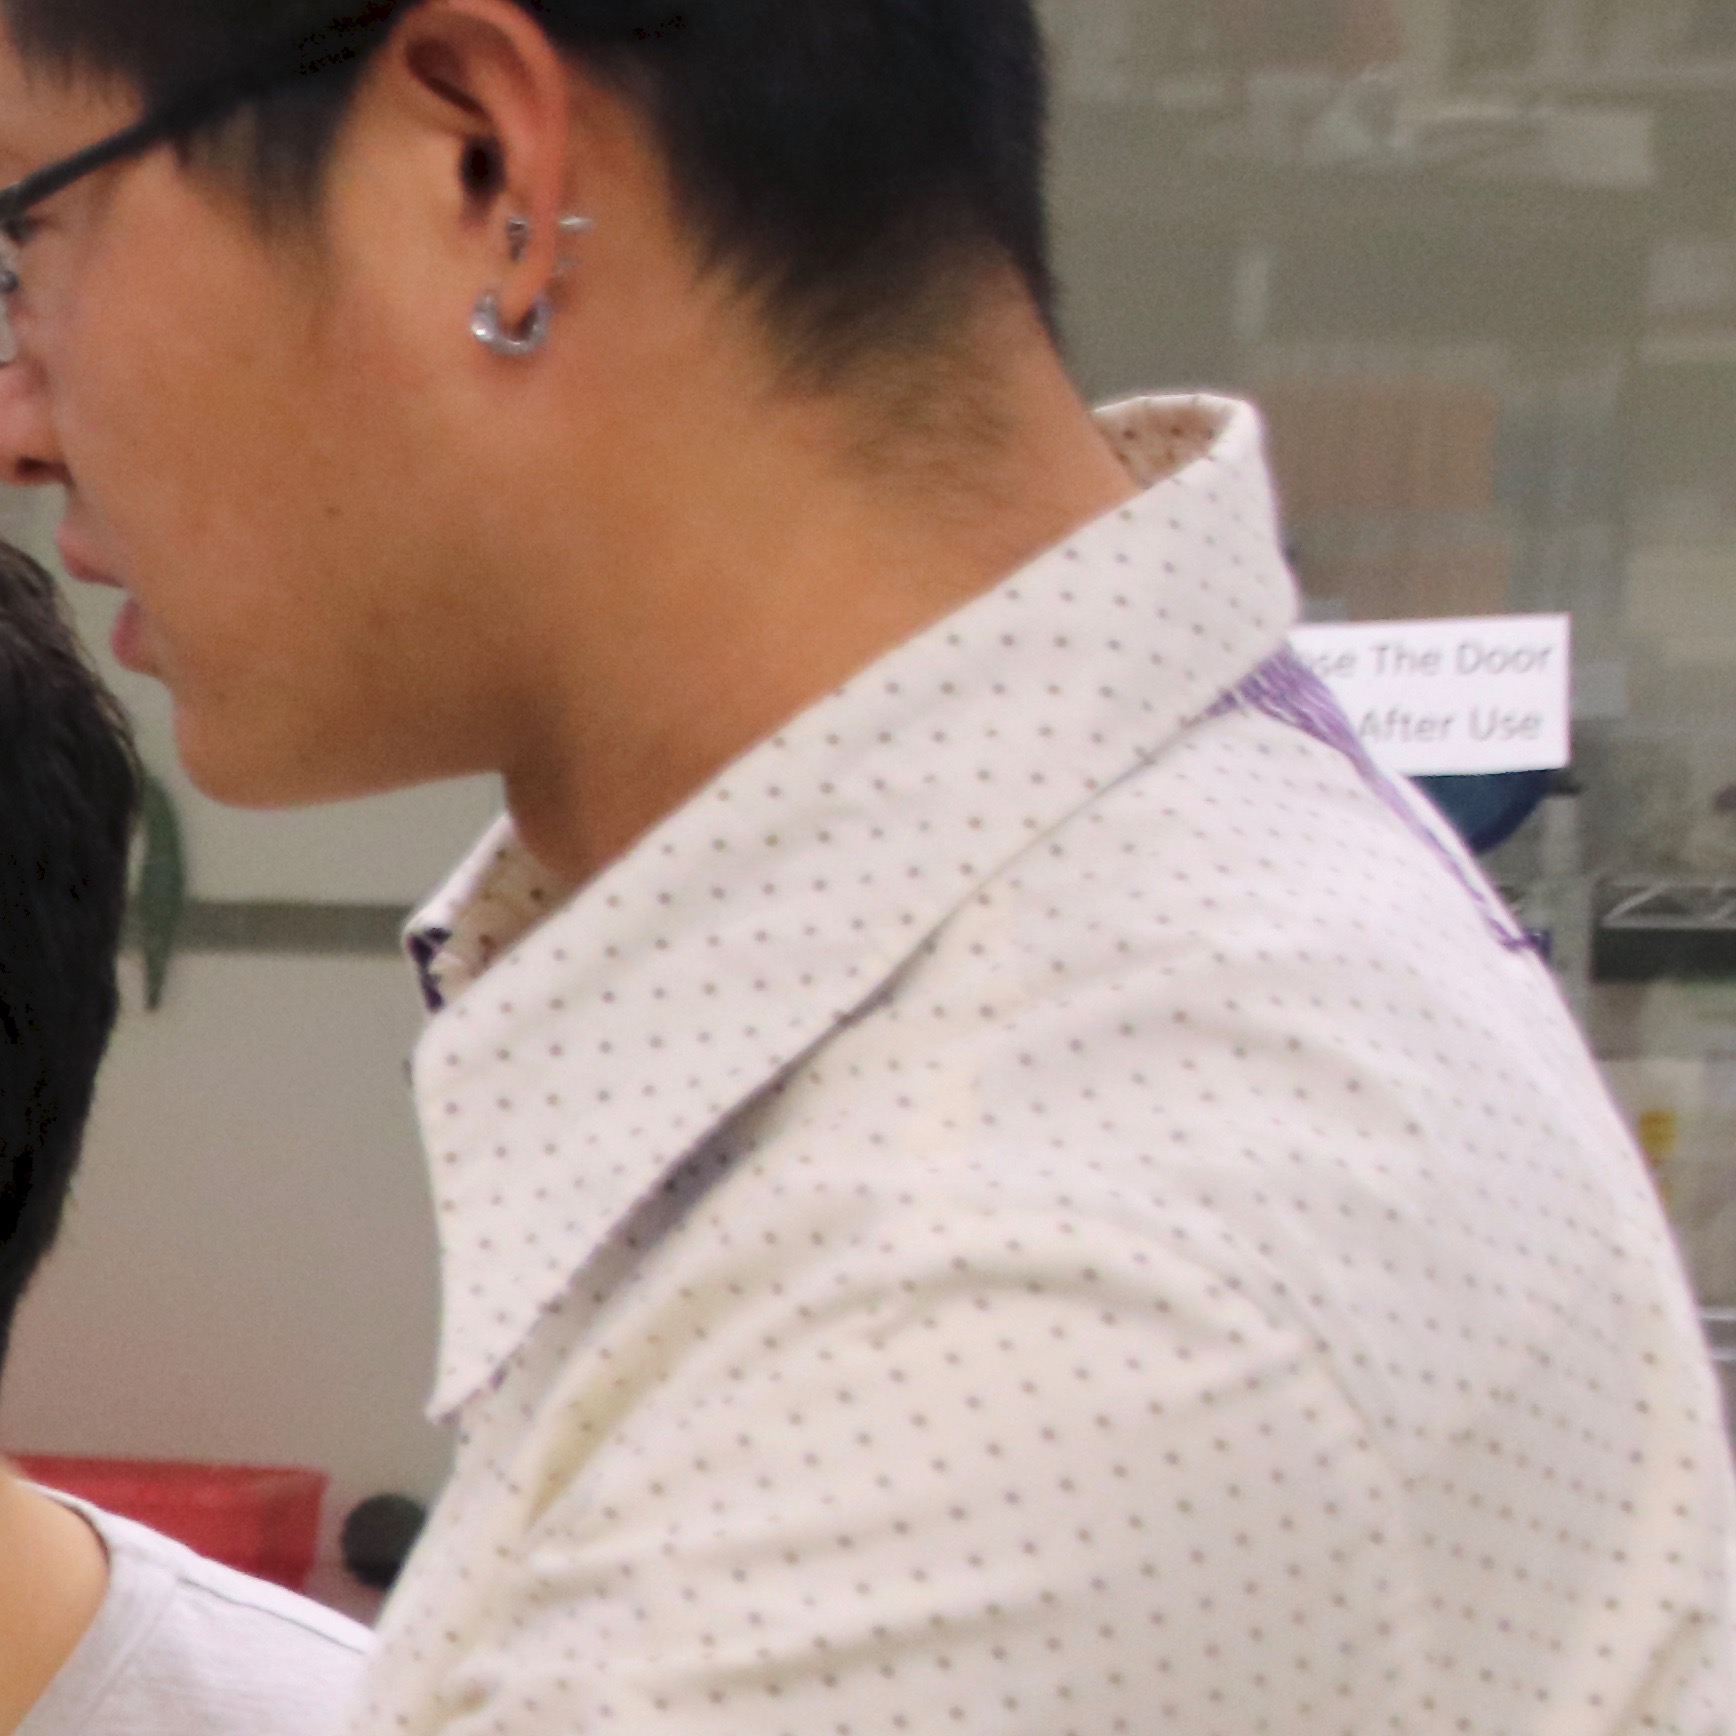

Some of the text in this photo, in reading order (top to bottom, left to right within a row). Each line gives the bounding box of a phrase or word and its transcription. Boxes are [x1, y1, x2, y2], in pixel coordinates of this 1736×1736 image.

[1369, 640, 1443, 677] The
[1455, 639, 1554, 676] Door
[1359, 706, 1546, 743] After Use
